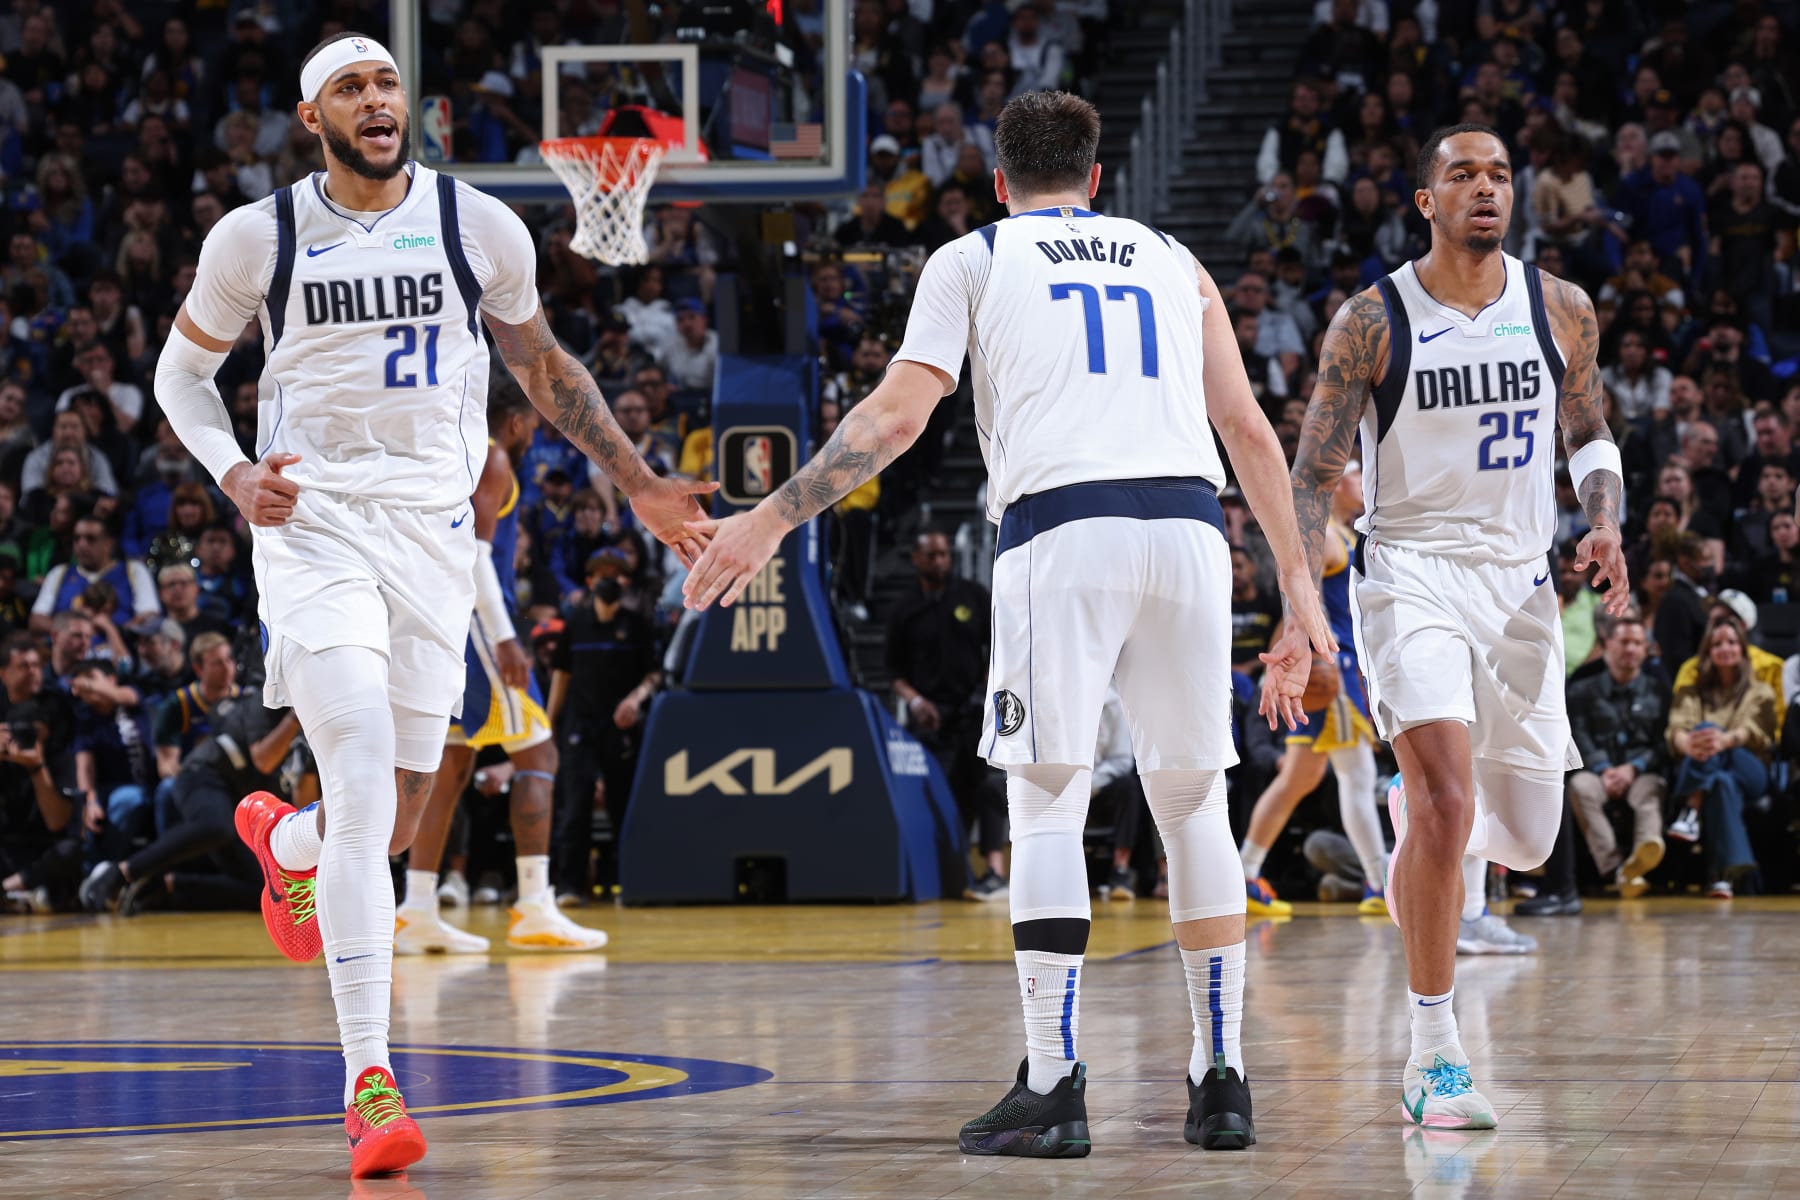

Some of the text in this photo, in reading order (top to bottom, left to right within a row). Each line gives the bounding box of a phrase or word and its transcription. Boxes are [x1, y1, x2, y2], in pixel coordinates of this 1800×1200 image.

[393, 234, 436, 250] chime
[1035, 236, 1137, 268] DONČIĆ
[302, 272, 444, 326] DALLAS
[1048, 282, 1160, 380] 77
[1494, 323, 1531, 337] chime
[384, 324, 441, 389] 21
[1414, 359, 1541, 412] DALLAS
[1477, 408, 1540, 472] 25
[736, 558, 787, 603] HE
[730, 606, 787, 652] APP
[664, 747, 854, 796] KIA
